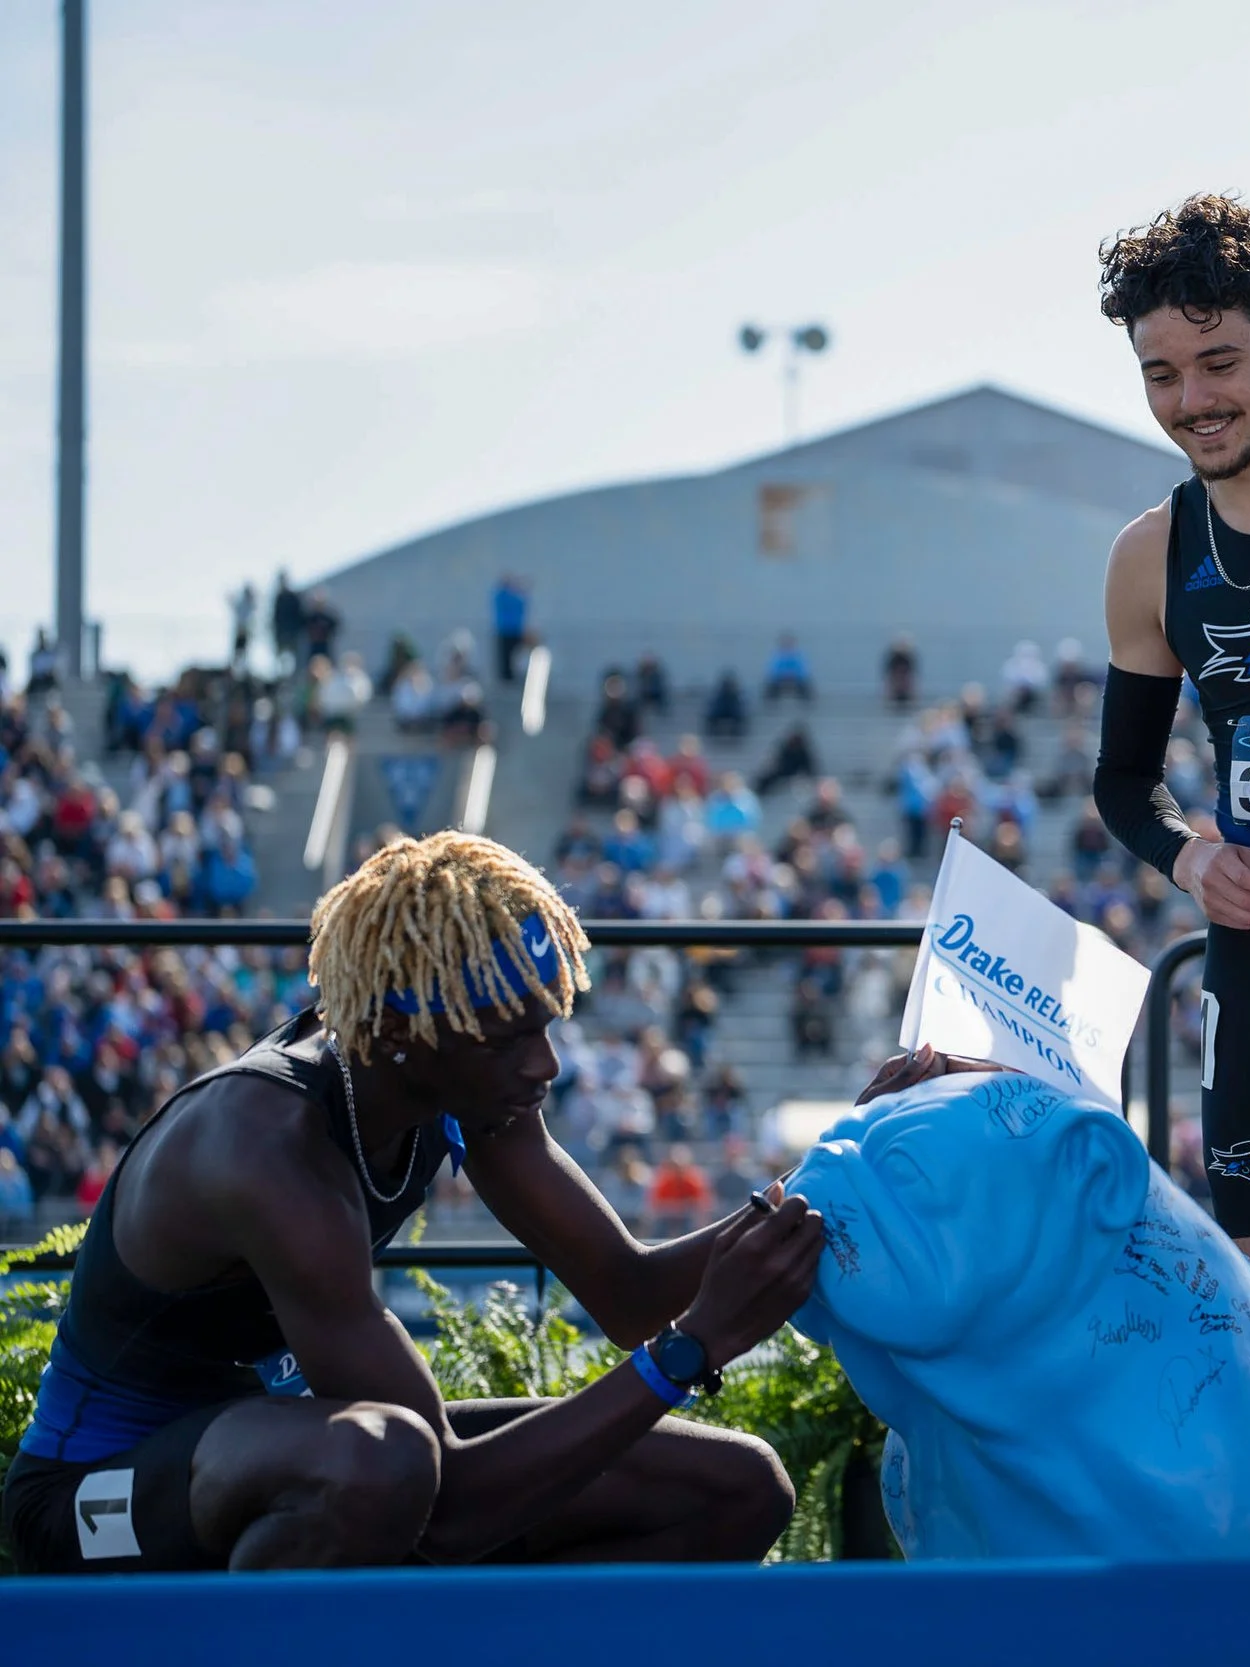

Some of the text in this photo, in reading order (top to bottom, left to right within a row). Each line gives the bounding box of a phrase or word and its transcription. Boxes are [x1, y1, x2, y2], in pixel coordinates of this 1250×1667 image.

[1185, 575, 1224, 591] adidas
[937, 914, 1102, 1048] Drake RELAYS
[81, 1497, 127, 1535] 1
